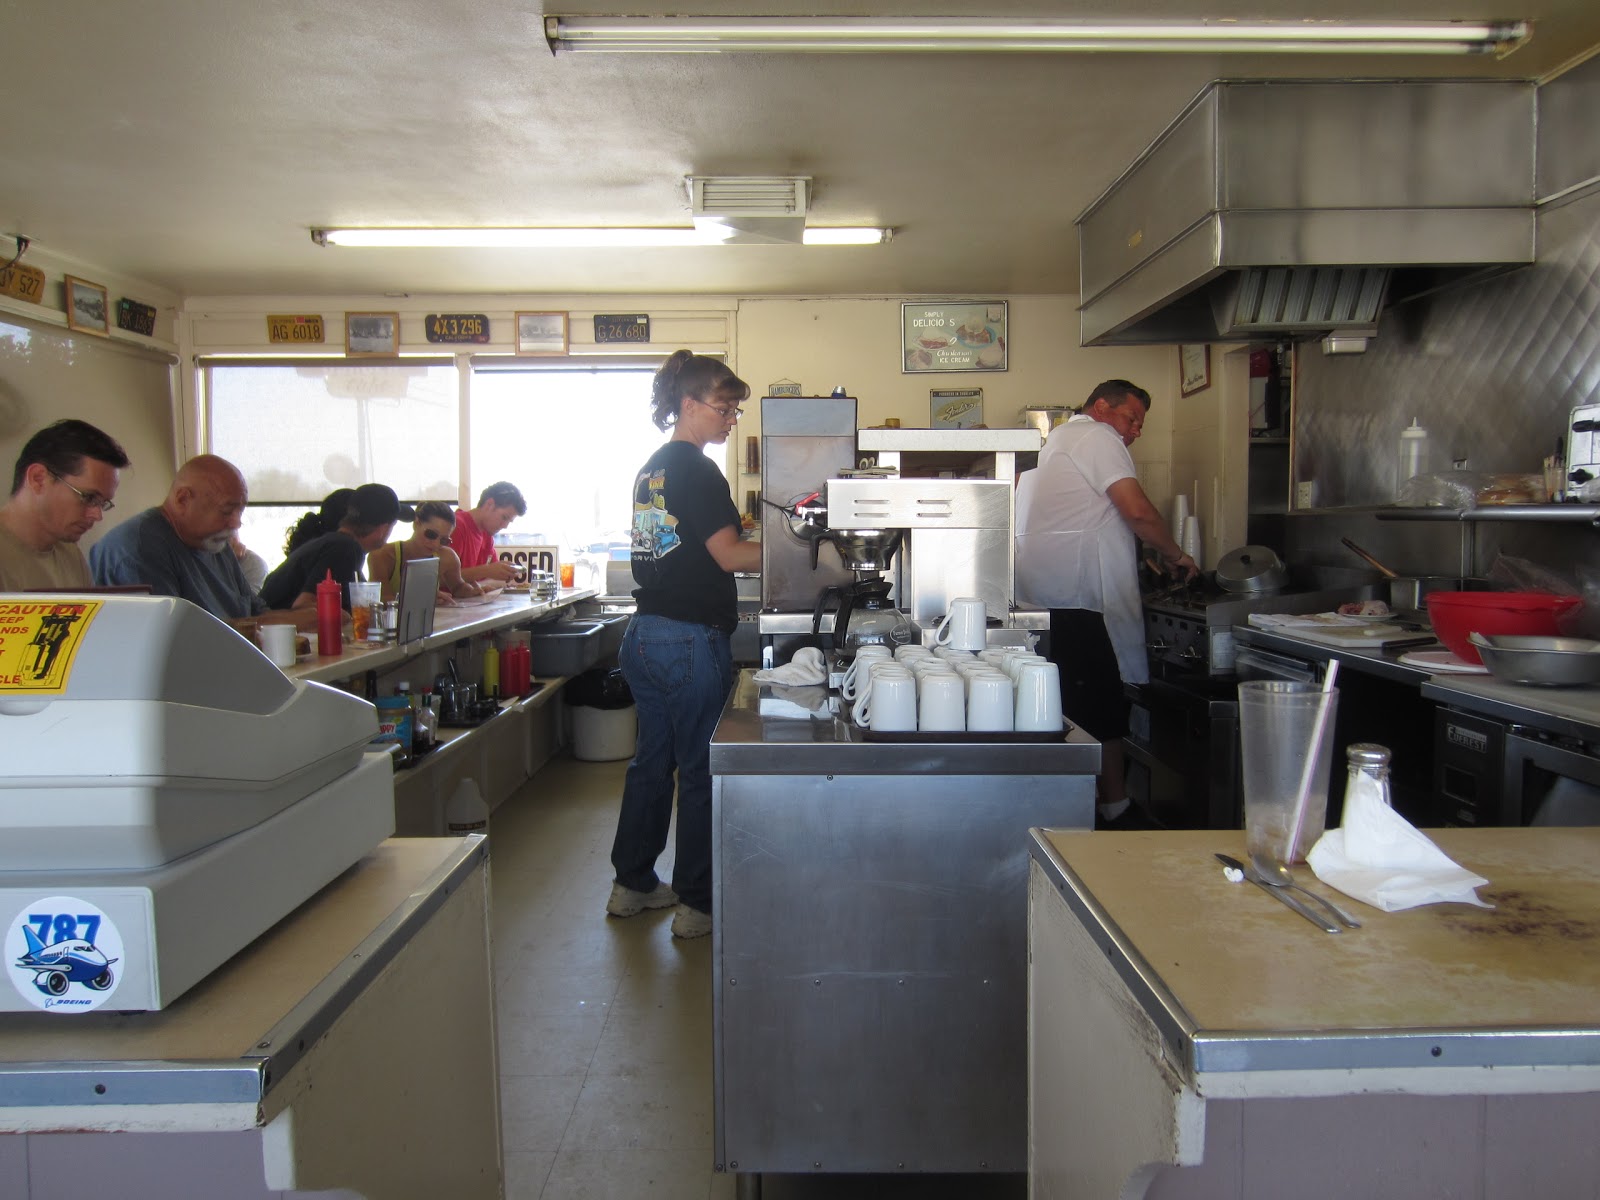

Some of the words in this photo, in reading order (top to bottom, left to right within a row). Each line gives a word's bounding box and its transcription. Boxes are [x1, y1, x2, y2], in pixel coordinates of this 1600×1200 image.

[19, 274, 40, 297] 527
[272, 324, 289, 340] AG
[292, 324, 321, 340] 6018
[460, 319, 482, 335] 296
[608, 324, 623, 339] 26
[625, 324, 647, 339] 680
[0, 604, 88, 615] CAUTION
[28, 913, 102, 945] 787
